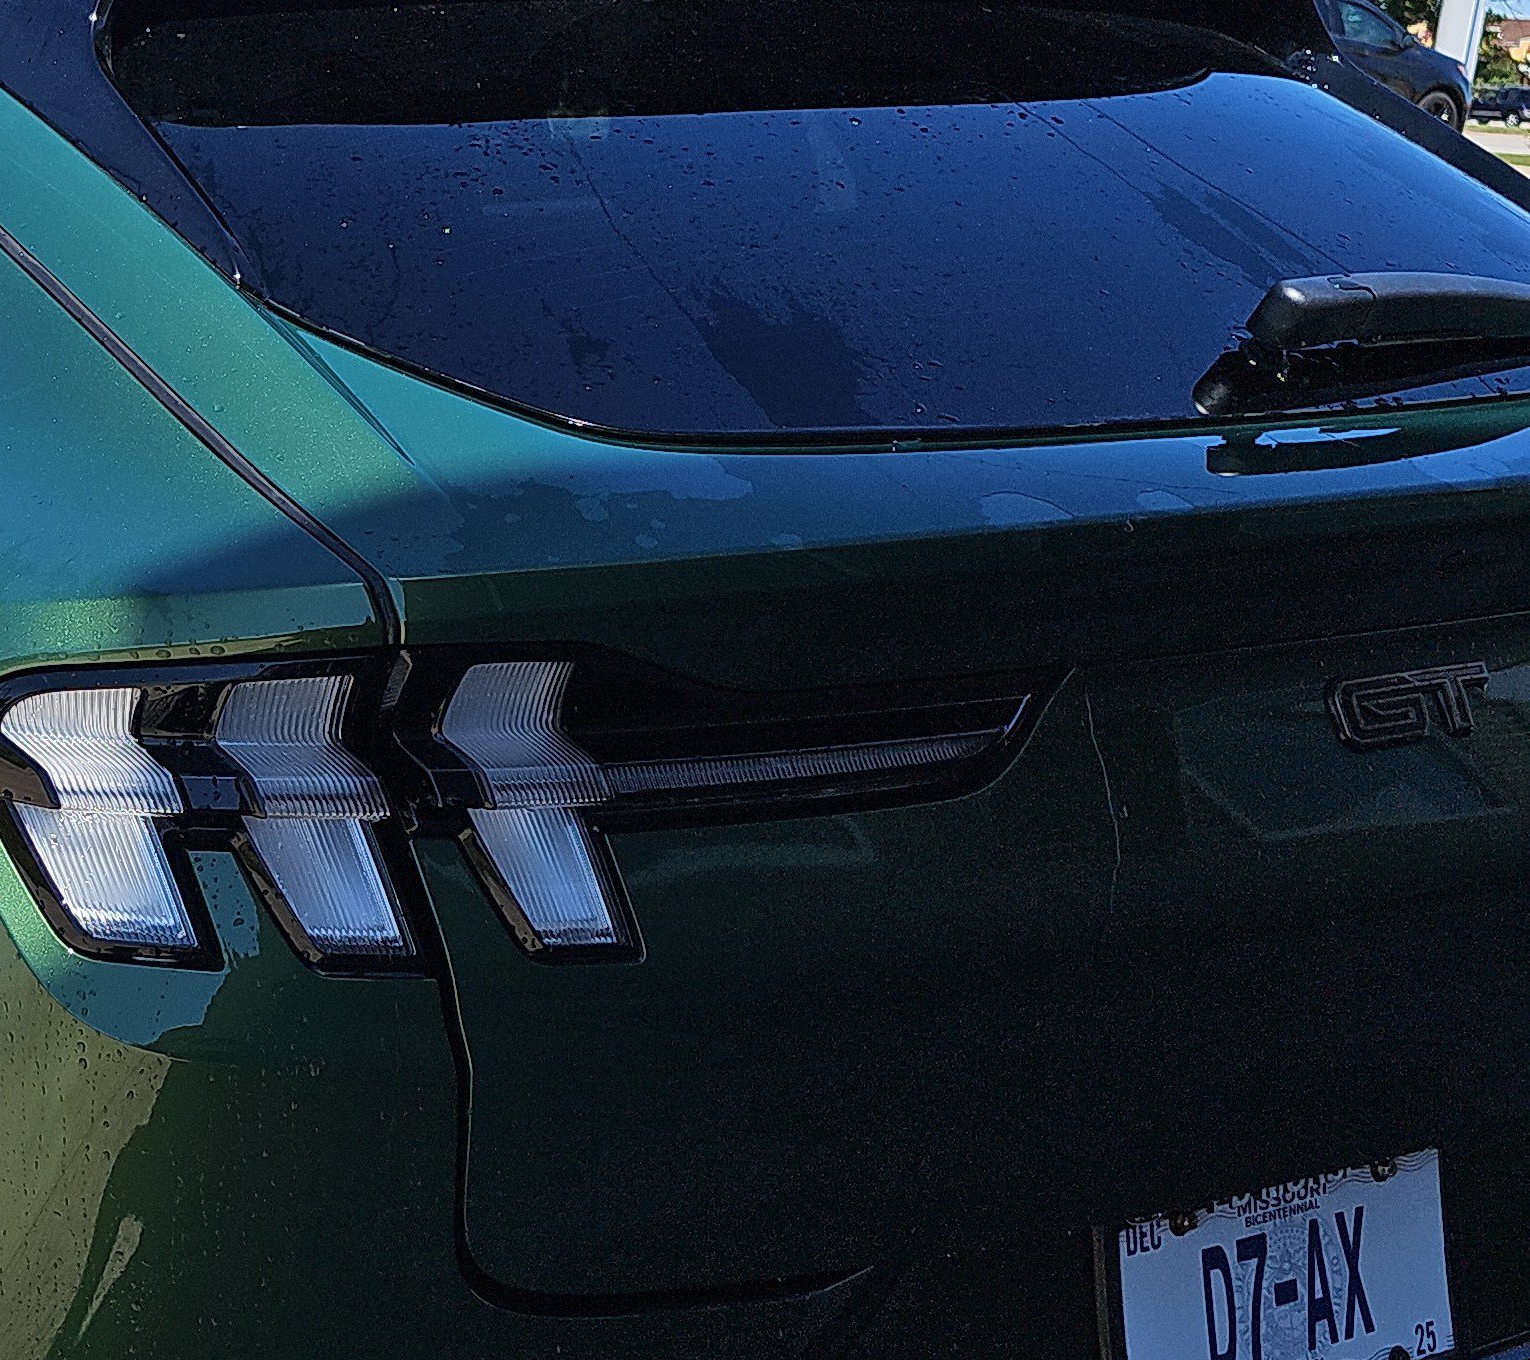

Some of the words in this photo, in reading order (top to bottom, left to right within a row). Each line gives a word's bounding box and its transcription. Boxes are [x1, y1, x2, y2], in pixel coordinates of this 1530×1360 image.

[1328, 661, 1489, 743] GT
[1236, 1180, 1327, 1218] MISSOURI
[1245, 1199, 1320, 1228] BICENTENNIAL
[1126, 1221, 1163, 1256] DEC
[1414, 1320, 1438, 1358] 25
